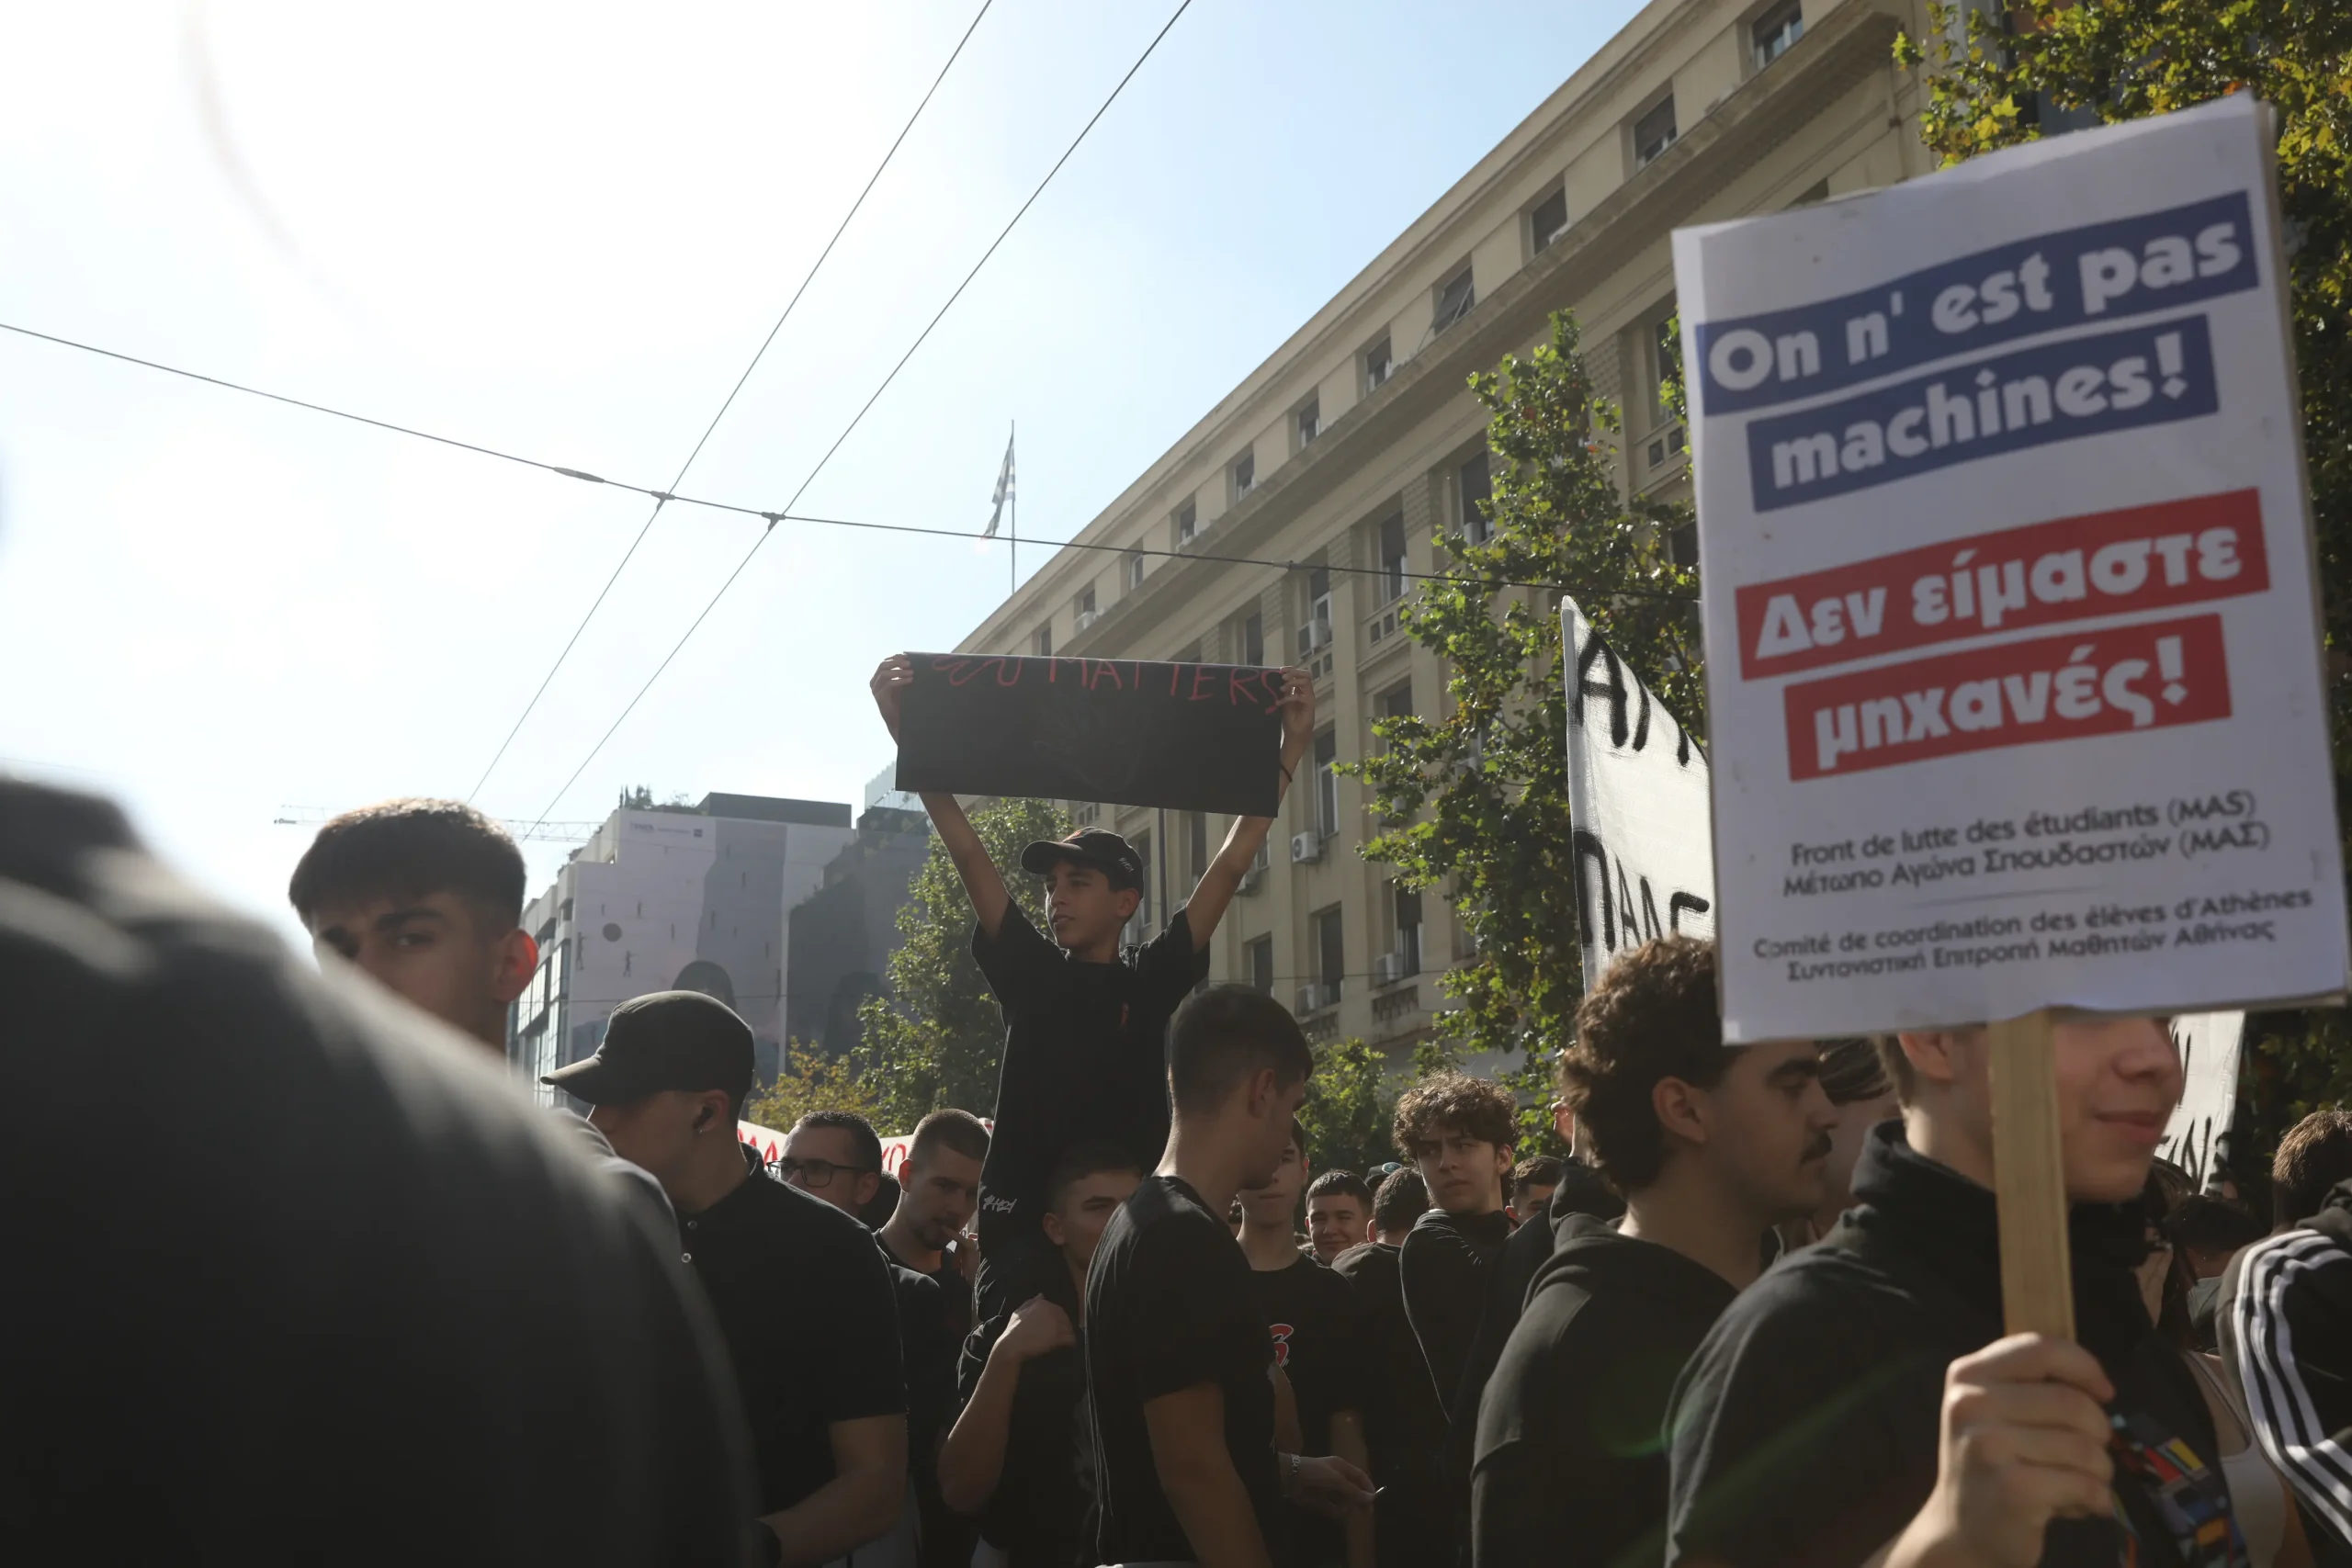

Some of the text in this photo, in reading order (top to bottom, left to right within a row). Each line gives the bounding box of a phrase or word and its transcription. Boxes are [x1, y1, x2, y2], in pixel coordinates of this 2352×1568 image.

[1708, 327, 1821, 392] On
[1931, 253, 2053, 334] est
[2078, 222, 2243, 315] pas
[1771, 332, 2188, 490] machines!
[1755, 526, 2243, 660] Δεν είμαστε
[1814, 635, 2188, 771] μηχανές!
[1782, 821, 2271, 897] Μέτωπο Αγώνα Σπουδαστών (ΜΑΣ)
[1791, 790, 2256, 866] Front de lutte des étudiants (MAS)
[1753, 932, 1832, 958] Comité
[1838, 931, 1868, 953] de
[1874, 916, 2021, 949] coordination
[2030, 909, 2078, 933] des
[2085, 901, 2167, 927] élèves
[1932, 939, 2041, 969] Επιτροπή
[2048, 929, 2167, 959] Μαθητών
